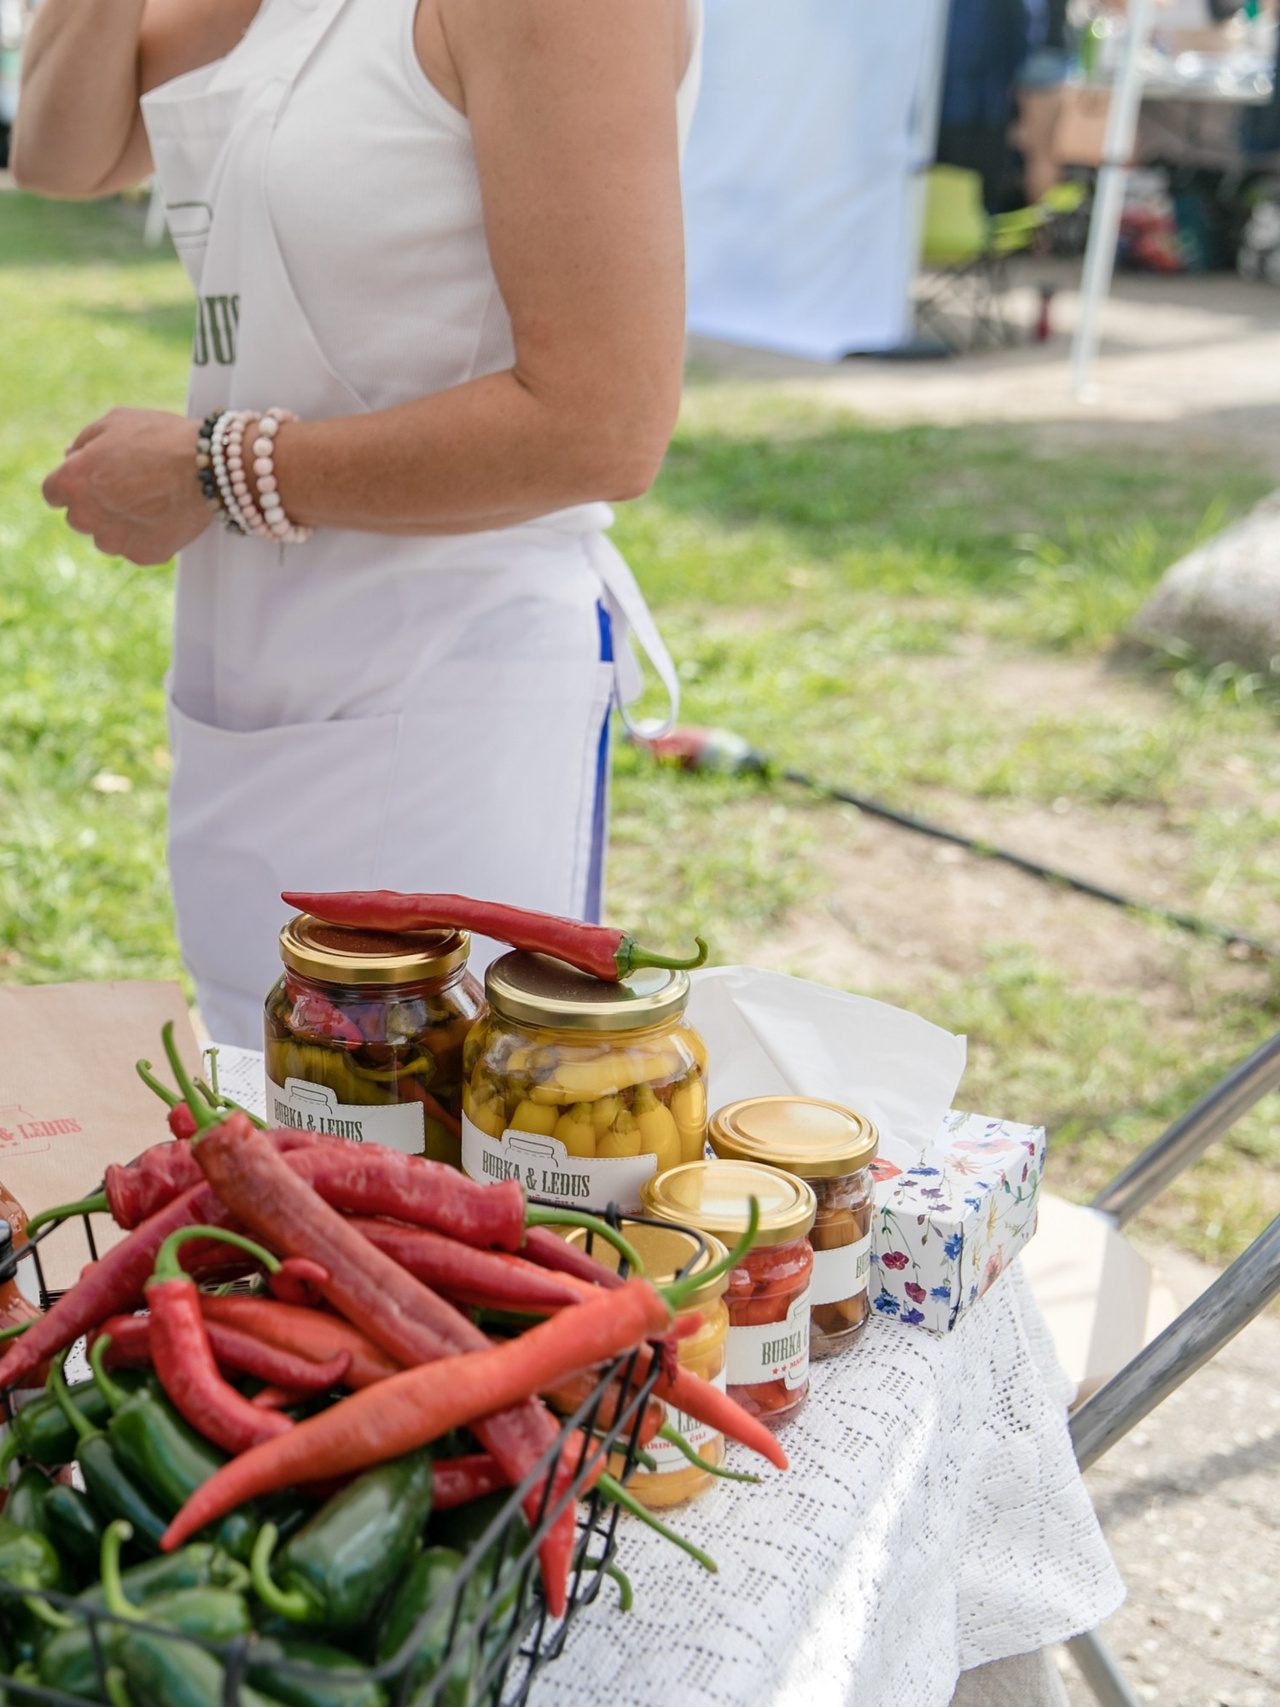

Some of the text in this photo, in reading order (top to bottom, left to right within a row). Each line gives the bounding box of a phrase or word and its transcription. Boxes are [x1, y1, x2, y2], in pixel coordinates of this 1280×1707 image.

[17, 1118, 83, 1140] LEDUS
[274, 1098, 303, 1131] BURKA
[306, 1113, 318, 1131] &
[482, 1150, 591, 1198] BURKA & LEDUS
[761, 1330, 802, 1366] BURKA
